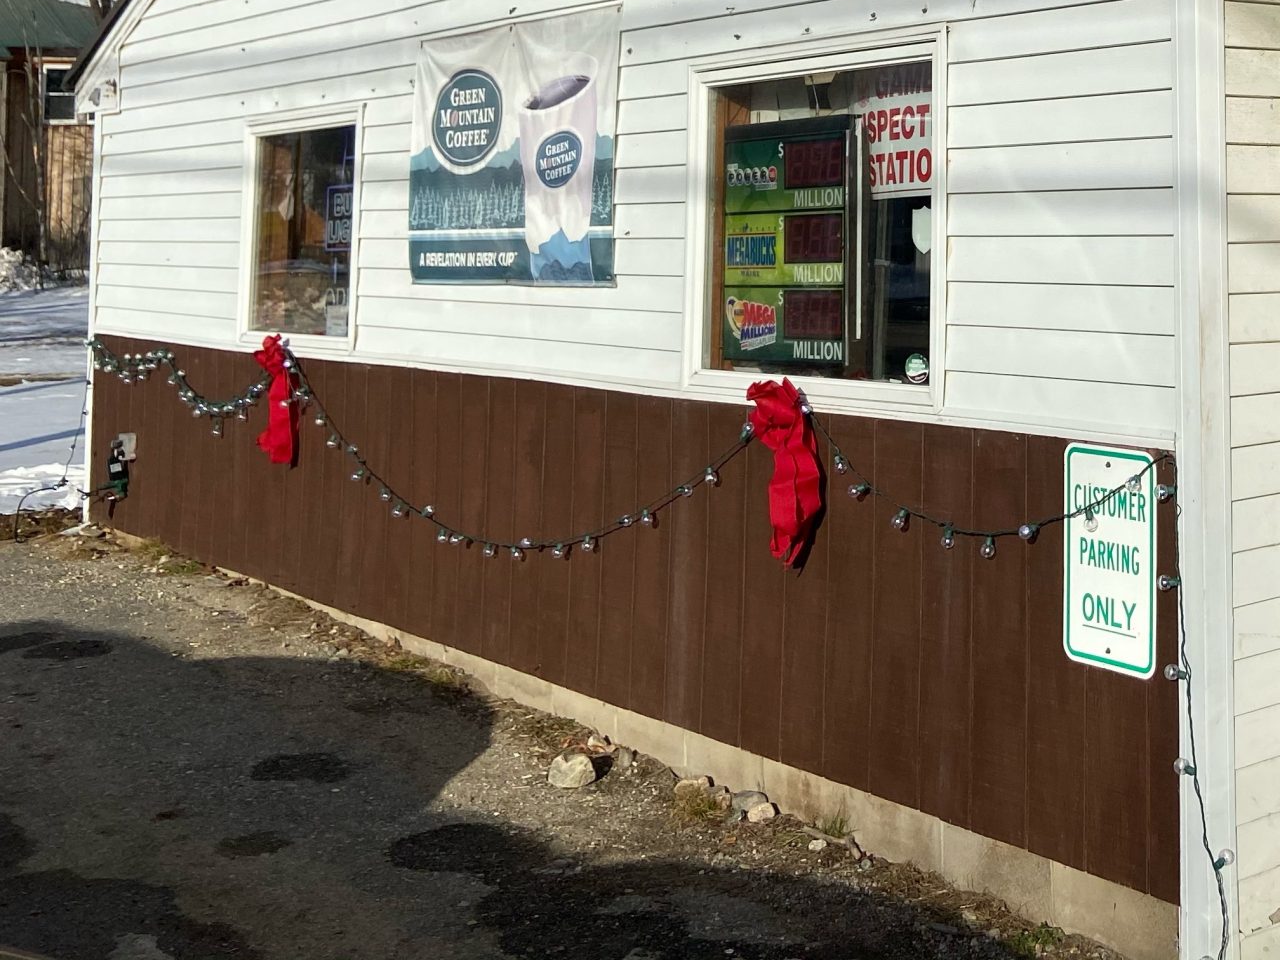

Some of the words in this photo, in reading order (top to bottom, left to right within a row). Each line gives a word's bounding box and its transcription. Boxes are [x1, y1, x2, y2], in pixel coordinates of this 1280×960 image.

[451, 88, 485, 106] GREEN
[440, 107, 494, 127] MOUNTAIN
[446, 129, 487, 148] COFFEE
[869, 148, 931, 187] STATIO
[334, 193, 352, 216] BU
[794, 188, 842, 207] MILLION
[328, 219, 351, 243] LIG
[420, 252, 425, 266] A
[426, 252, 466, 266] REVELATION
[467, 252, 475, 266] IN
[476, 252, 496, 266] EVERY
[728, 236, 776, 266] MEGABUCKS
[794, 265, 842, 282] MILLION
[744, 302, 775, 324] MEGA
[793, 341, 842, 360] MILLION
[1074, 484, 1146, 522] CUSTOMER
[1079, 537, 1140, 575] PARKING
[1082, 593, 1137, 631] ONLY
